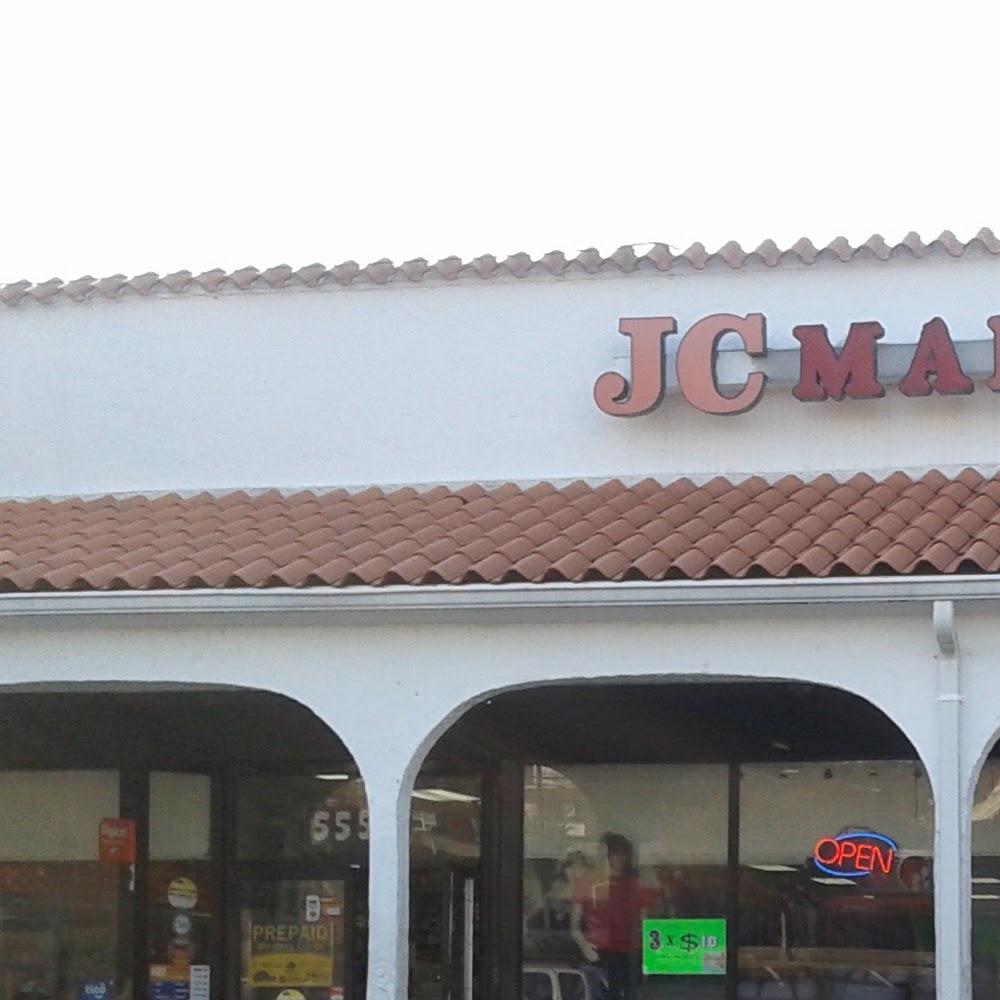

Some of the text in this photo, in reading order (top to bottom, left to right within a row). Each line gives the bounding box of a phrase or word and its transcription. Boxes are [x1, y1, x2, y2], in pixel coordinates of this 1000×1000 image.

[594, 313, 767, 417] JC
[814, 838, 894, 874] OPEN
[253, 926, 329, 941] PREPAID
[649, 930, 661, 951] 3
